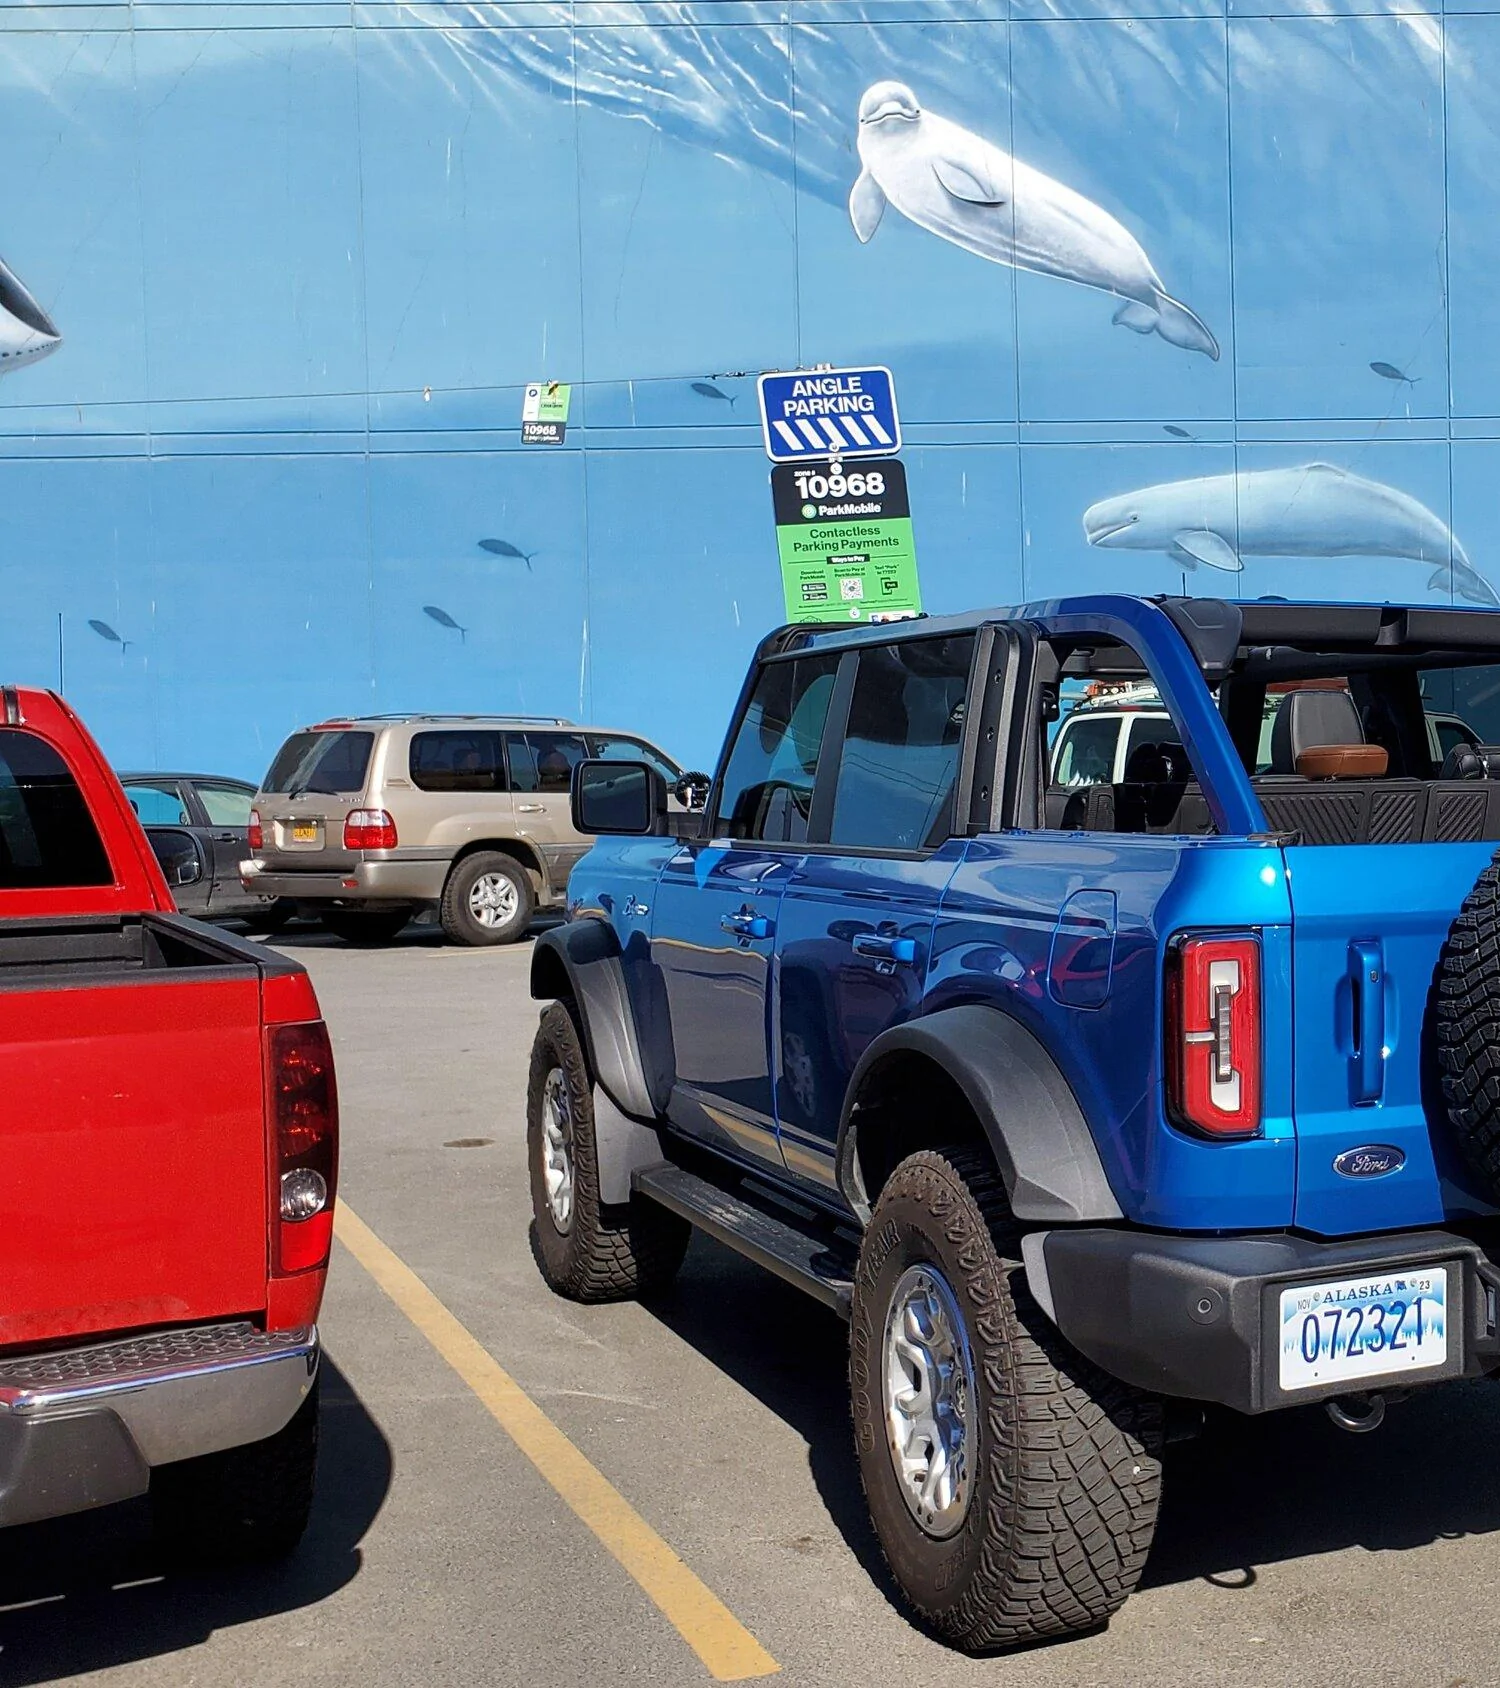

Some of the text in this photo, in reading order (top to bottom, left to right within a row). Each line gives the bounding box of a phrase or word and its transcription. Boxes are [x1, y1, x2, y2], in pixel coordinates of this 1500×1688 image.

[792, 376, 863, 397] ANGLE
[783, 395, 875, 417] PARKING
[524, 425, 557, 435] 10968
[795, 472, 885, 499] 10968
[818, 502, 882, 516] ParkMobile
[810, 526, 881, 539] Contactless
[793, 537, 900, 552] Parking Payments
[1352, 1153, 1391, 1172] Ford
[1323, 1282, 1394, 1303] ALASKA
[1419, 1280, 1431, 1291] 23
[1297, 1299, 1312, 1311] NOV
[1301, 1297, 1423, 1364] 072321
